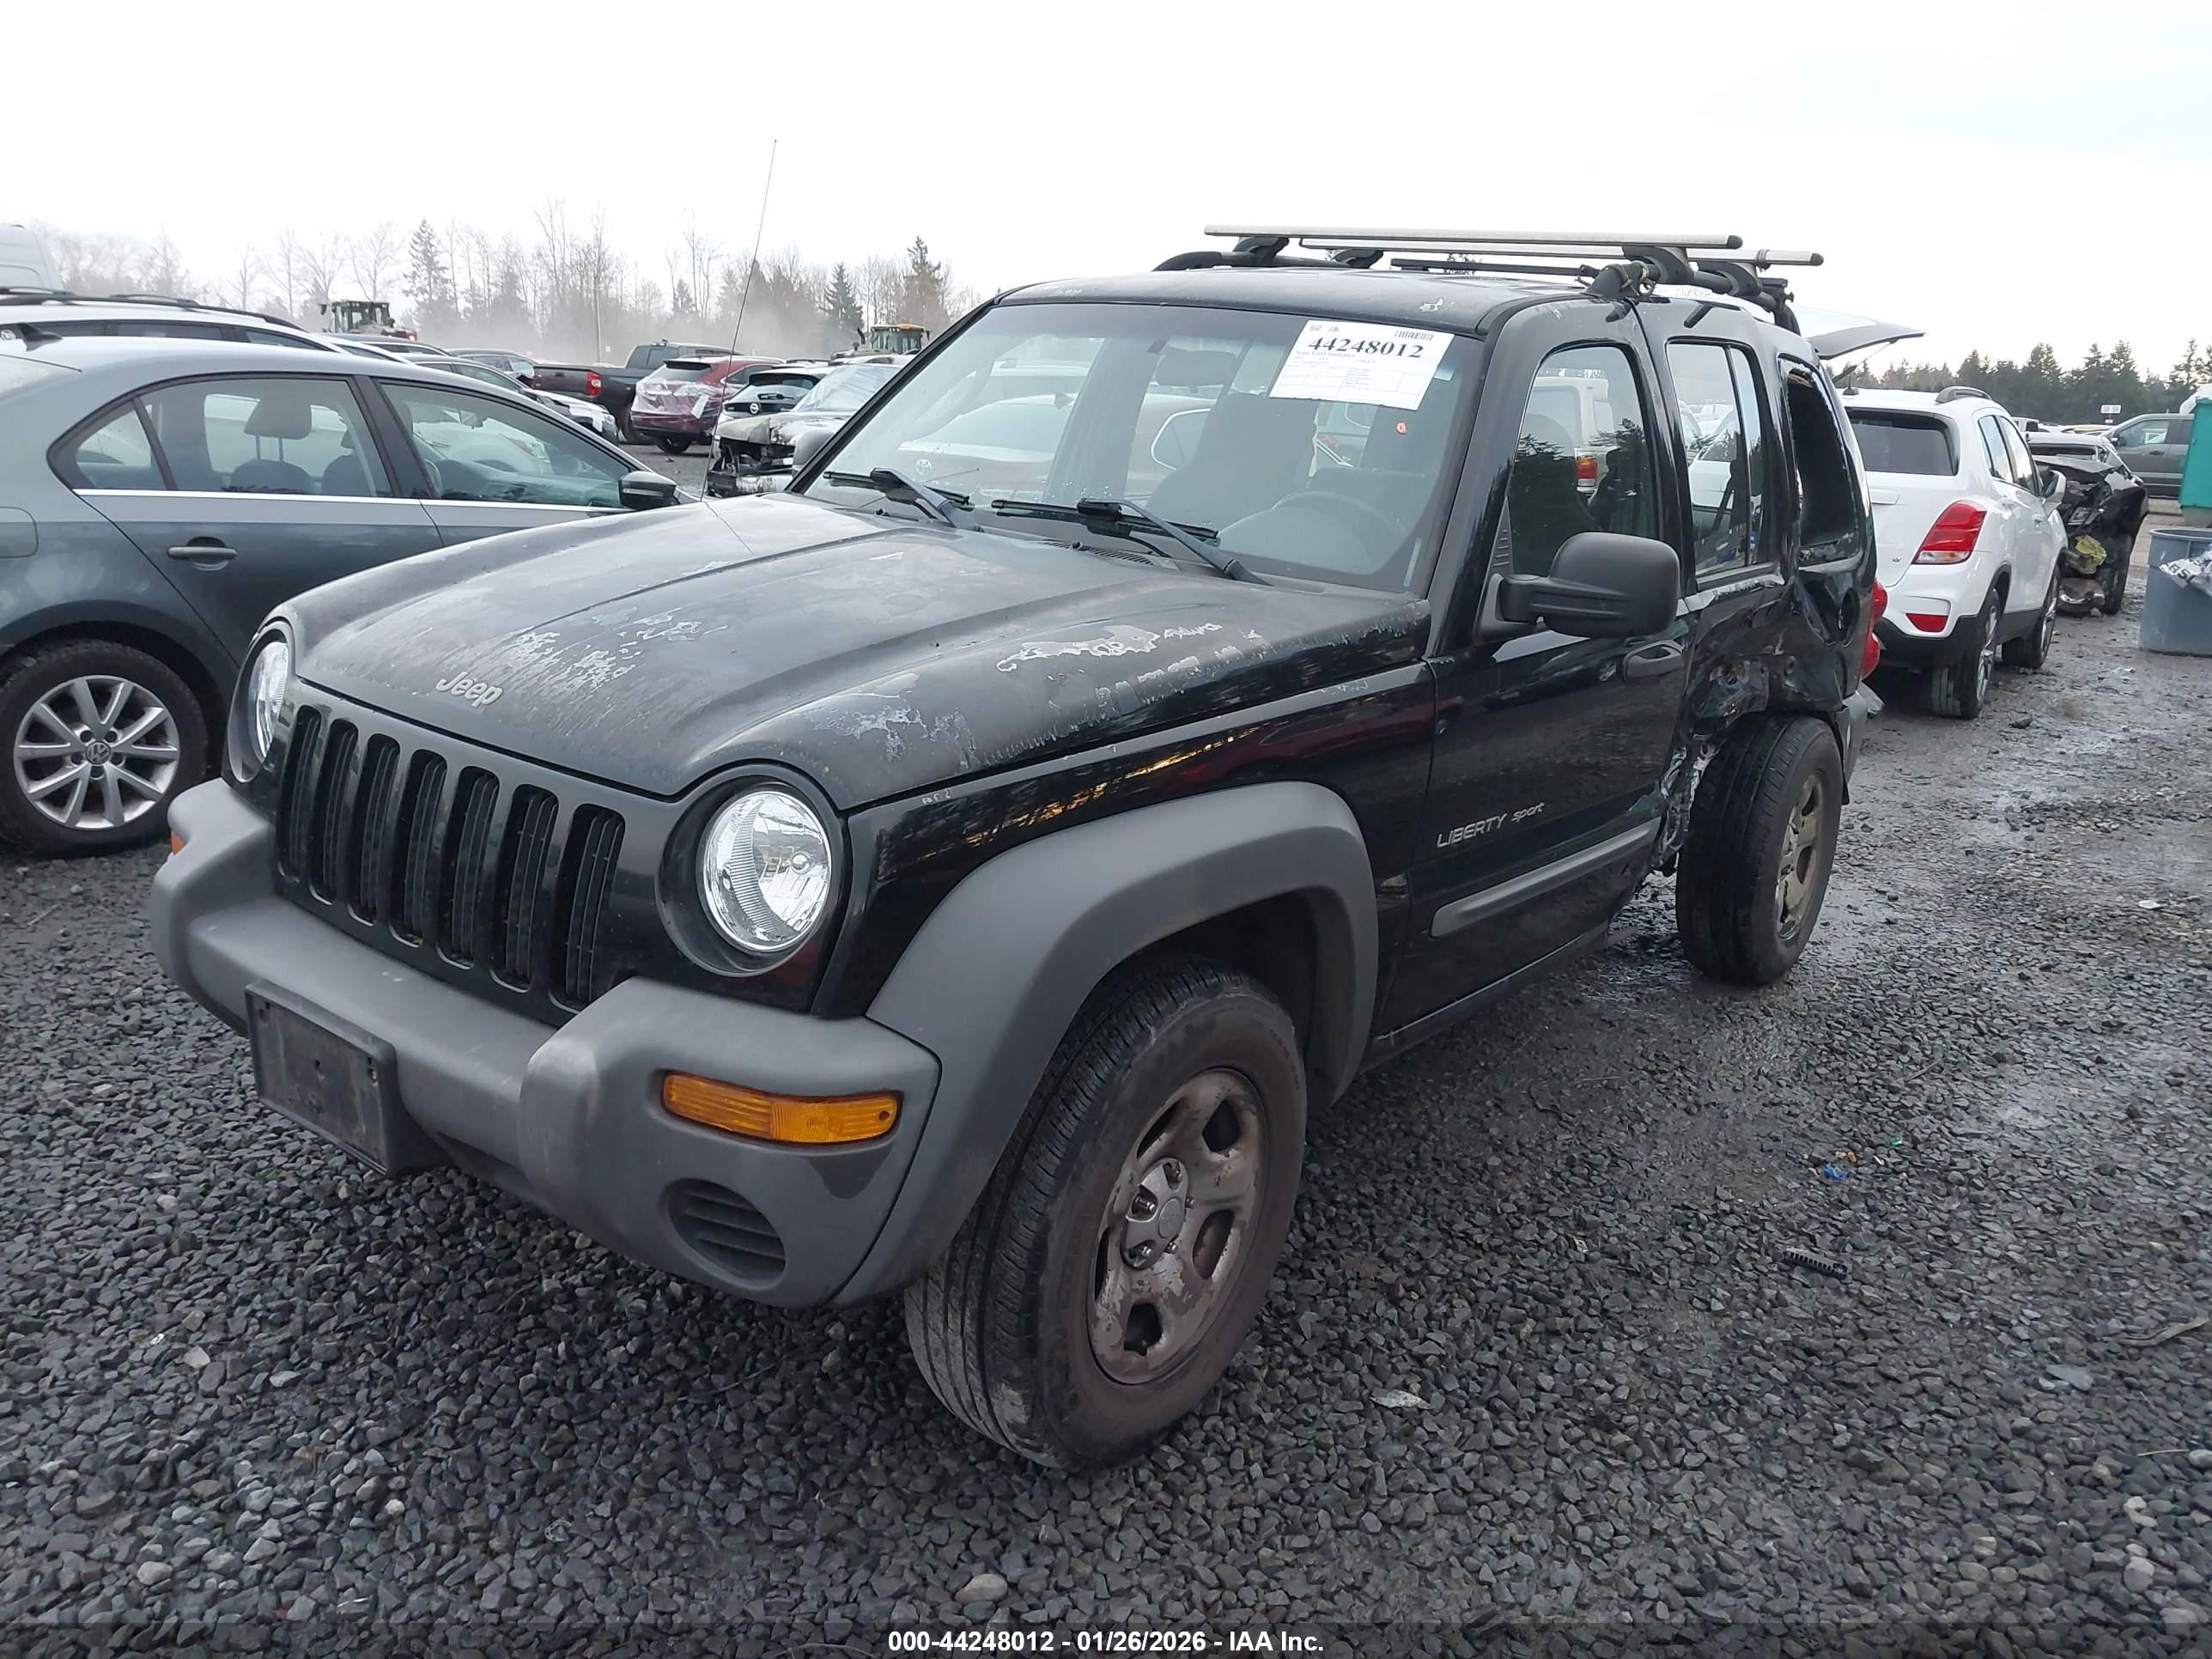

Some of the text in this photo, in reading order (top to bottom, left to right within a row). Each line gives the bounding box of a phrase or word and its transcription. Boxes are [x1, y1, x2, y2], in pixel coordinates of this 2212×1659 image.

[1308, 337, 1425, 359] 44248012
[435, 671, 503, 708] Jeep
[1436, 813, 1508, 848] LIBERTY
